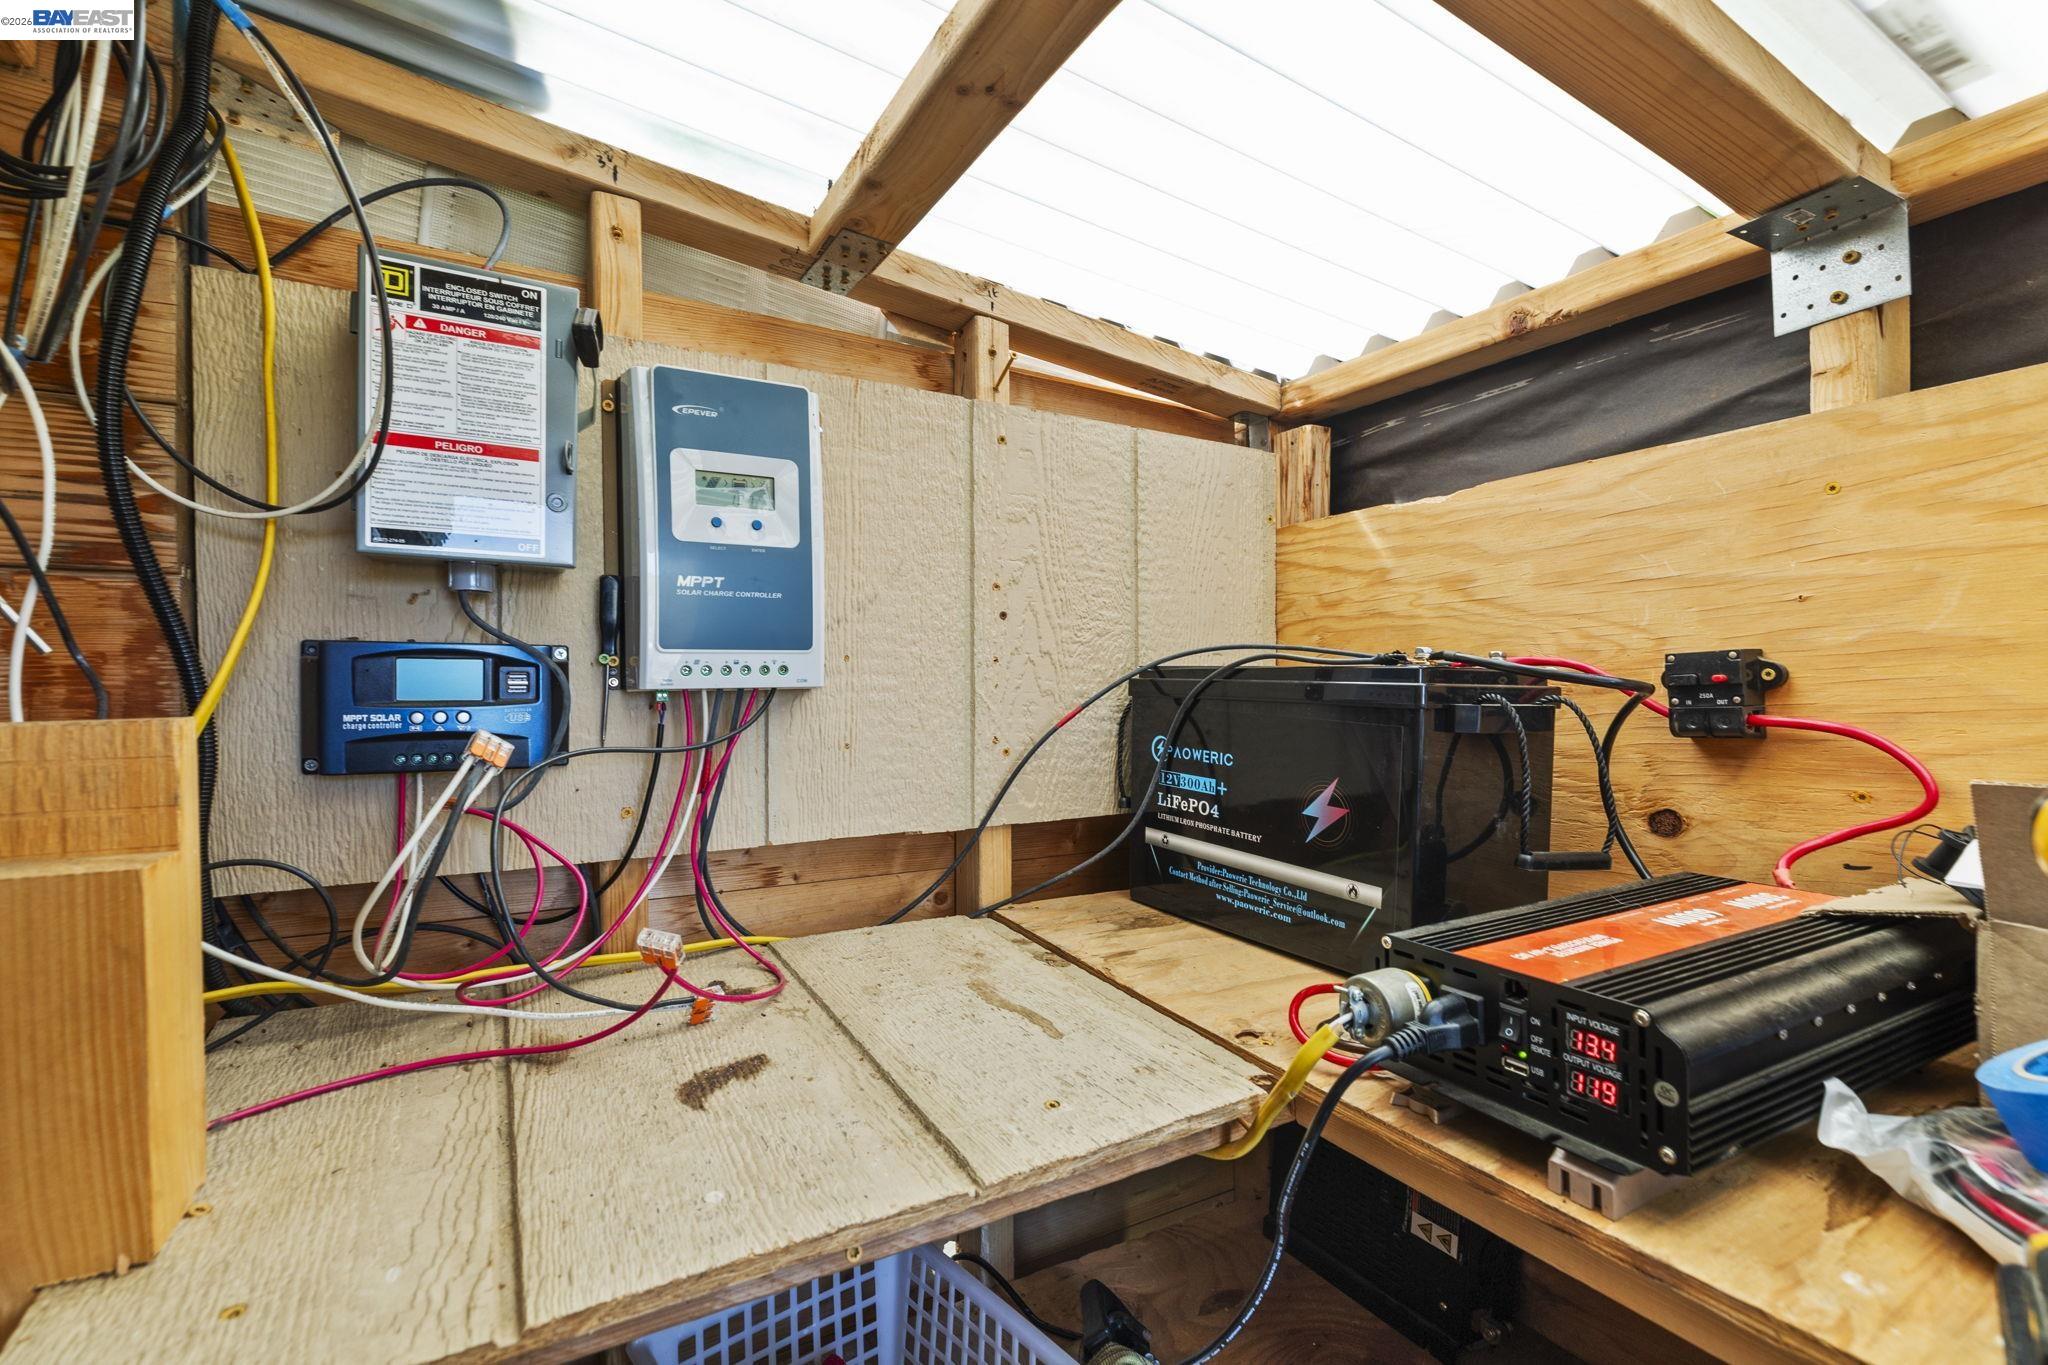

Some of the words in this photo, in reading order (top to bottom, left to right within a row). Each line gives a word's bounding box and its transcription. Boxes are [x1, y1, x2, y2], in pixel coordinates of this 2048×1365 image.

[422, 285, 482, 302] INTERRUPTEUR
[483, 296, 504, 306] SOUS
[505, 301, 540, 312] COFFRET
[445, 283, 488, 296] ENCLOSED
[489, 291, 518, 302] SWITCH
[521, 290, 538, 300] ON
[428, 293, 483, 309] INTERRUPTOR
[484, 303, 495, 311] EN
[496, 305, 534, 318] GABINETE
[440, 323, 487, 338] DANGER
[682, 407, 718, 417] EPEVER
[434, 441, 483, 453] PELIGRO
[517, 543, 540, 552] OFF
[677, 575, 725, 588] MPPT
[735, 591, 783, 599] CONTROLLER
[343, 714, 369, 722] MPPT
[370, 714, 402, 722] SOLAR
[343, 723, 367, 731] charge
[367, 722, 402, 730] controller
[1157, 791, 1220, 818] LiFePO4
[1157, 812, 1179, 823] LITHIUM
[1231, 829, 1262, 843] BATTERY
[1169, 865, 1188, 879] Contact
[1189, 871, 1208, 886] Method
[1208, 879, 1222, 890] after
[1249, 875, 1281, 895] Technology
[1215, 893, 1292, 923] www.paoweric.com
[1530, 1016, 1541, 1026] ON
[1566, 1012, 1587, 1025] INPUT
[1589, 1019, 1620, 1036] VOLTAGE
[1530, 1034, 1544, 1045] OFF
[1577, 1031, 1616, 1063] 13.4
[1530, 1043, 1552, 1058] REMOTE
[1530, 1065, 1545, 1077] USB
[1562, 1052, 1590, 1069] OUTPUT
[1592, 1062, 1623, 1081] VOLTAGE
[1577, 1072, 1617, 1107] 119
